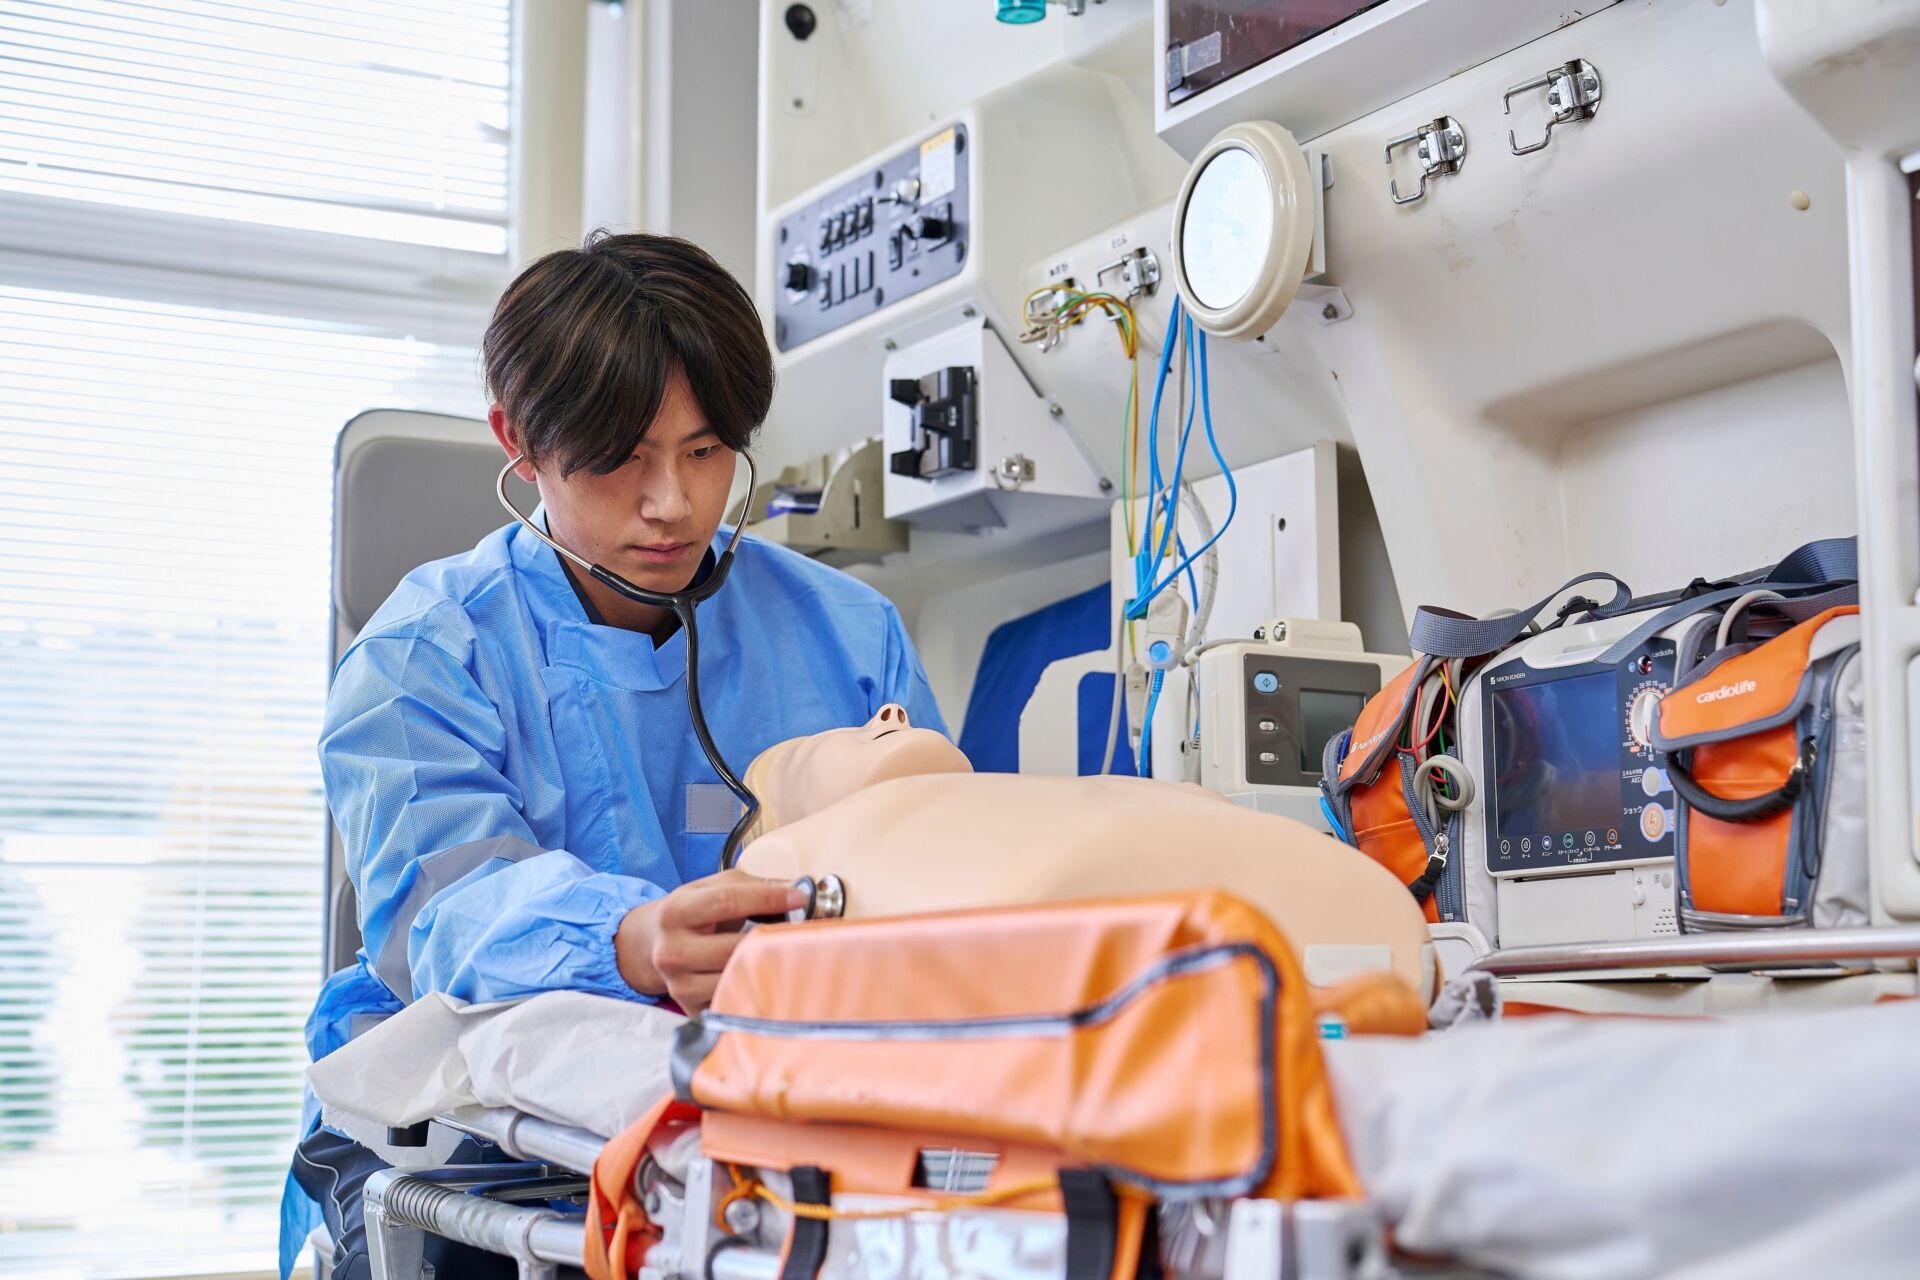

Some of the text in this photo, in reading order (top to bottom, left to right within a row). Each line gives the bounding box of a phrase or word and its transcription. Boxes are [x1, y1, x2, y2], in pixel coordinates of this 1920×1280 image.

[1696, 680, 1756, 704] cardiolife
[1623, 806, 1643, 815] ショック
